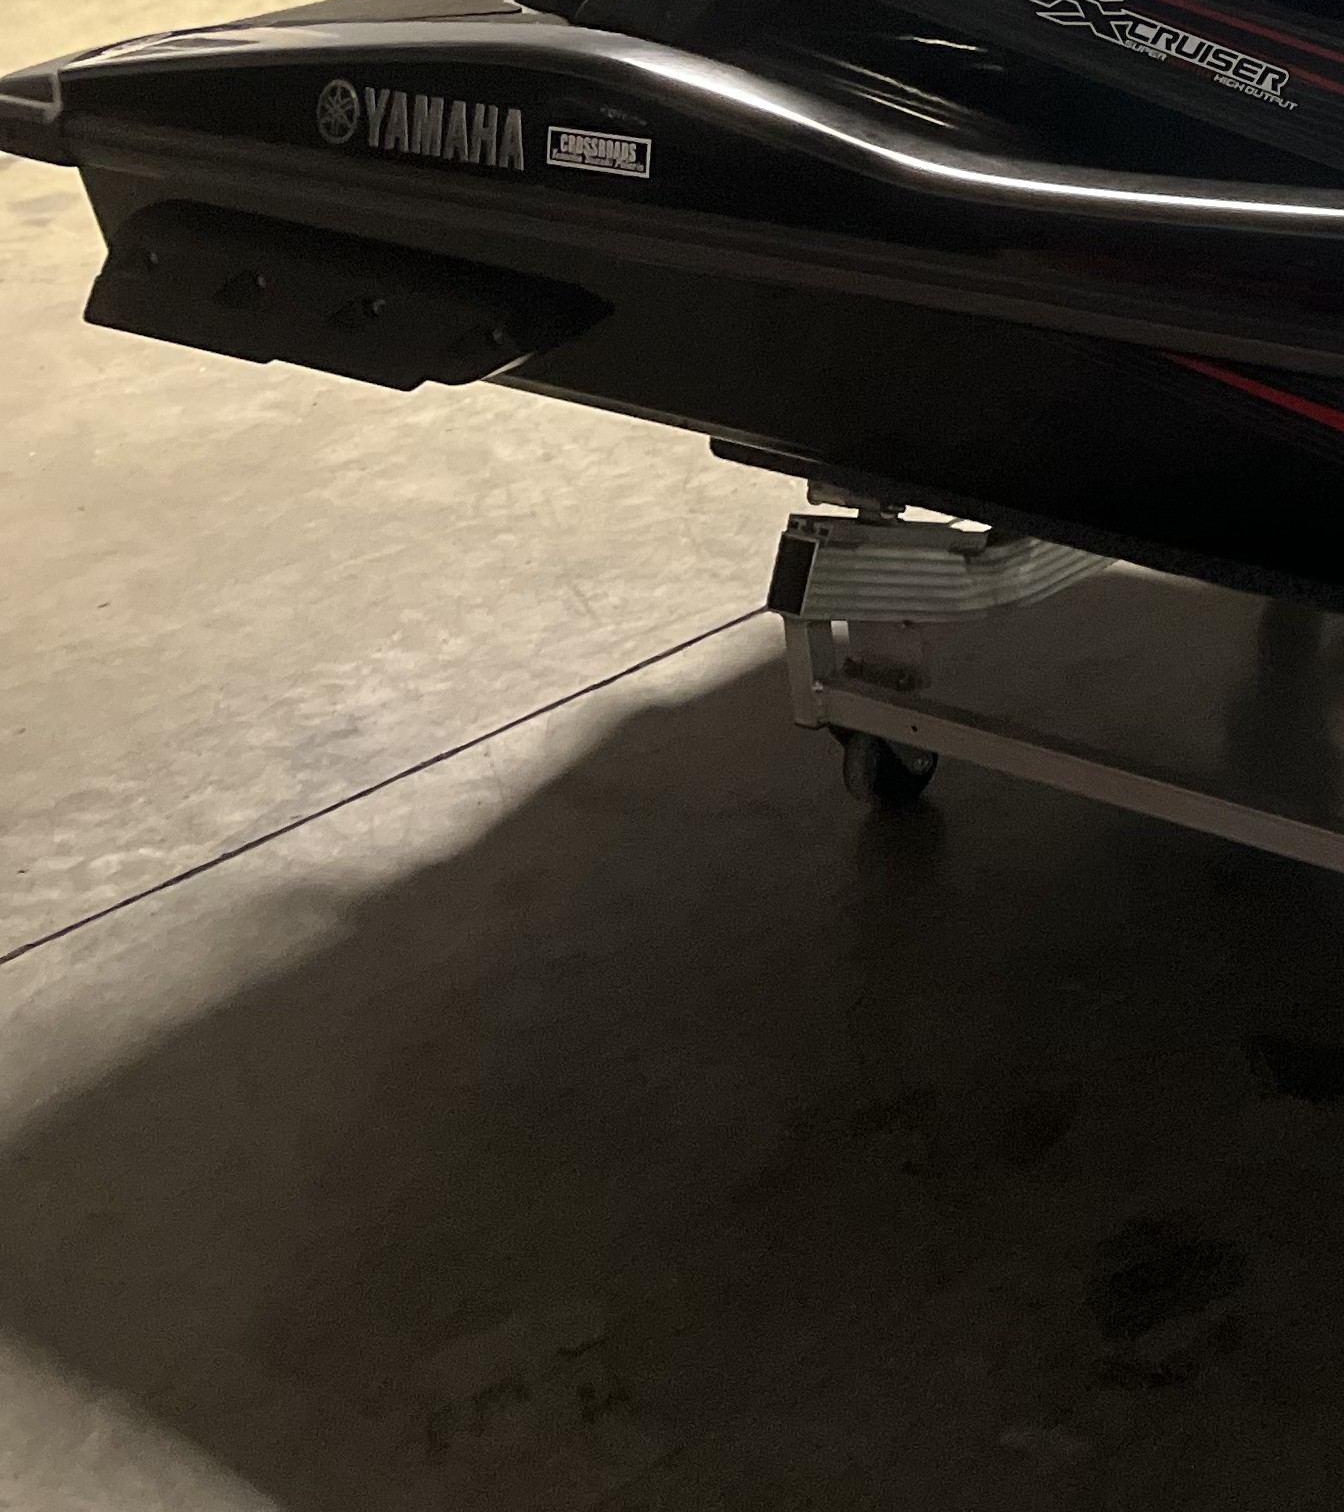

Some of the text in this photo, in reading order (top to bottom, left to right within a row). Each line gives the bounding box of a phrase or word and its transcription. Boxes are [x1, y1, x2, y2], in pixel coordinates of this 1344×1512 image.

[1124, 40, 1299, 112] SUPER HIGH OUTPUT
[365, 86, 525, 171] YAMAHA
